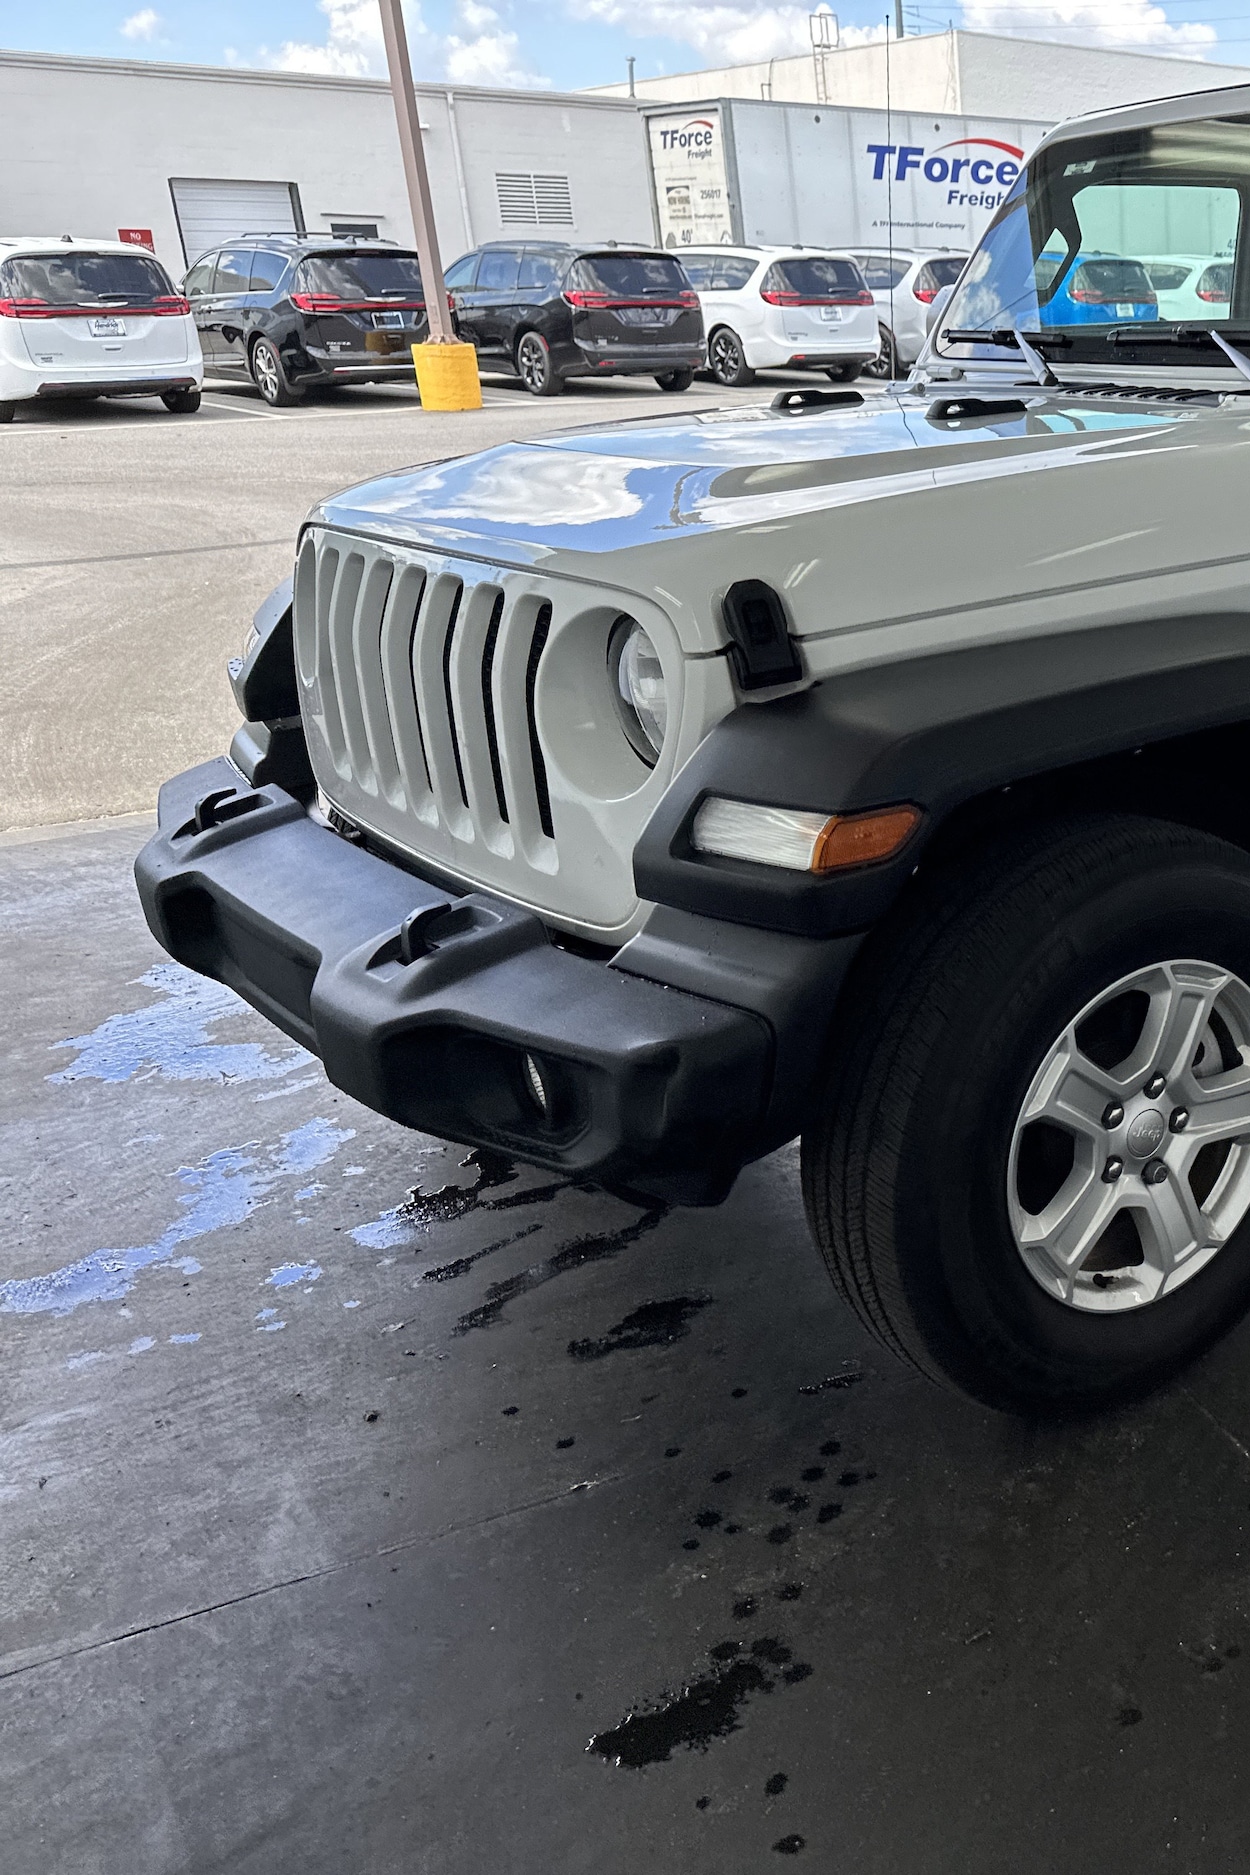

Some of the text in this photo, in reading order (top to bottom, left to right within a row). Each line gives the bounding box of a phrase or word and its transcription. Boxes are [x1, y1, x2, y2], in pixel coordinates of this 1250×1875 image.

[660, 130, 712, 149] TForce
[687, 149, 712, 160] Freight
[866, 144, 1019, 186] TForce
[947, 190, 1004, 209] Freigh
[935, 222, 965, 230] Company
[130, 232, 142, 240] NO
[1132, 1124, 1162, 1142] Jeep
